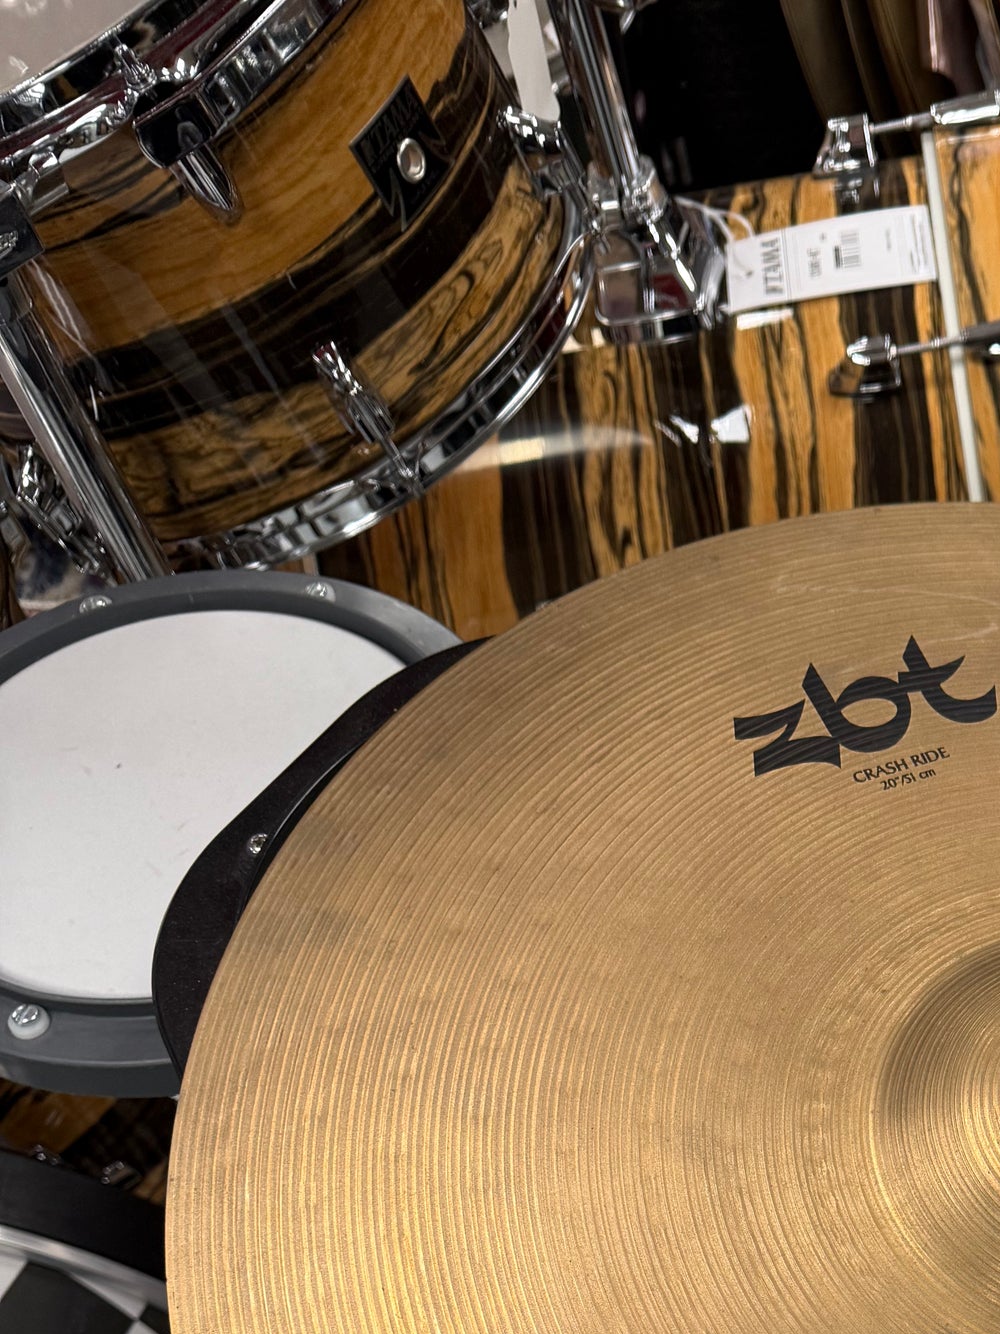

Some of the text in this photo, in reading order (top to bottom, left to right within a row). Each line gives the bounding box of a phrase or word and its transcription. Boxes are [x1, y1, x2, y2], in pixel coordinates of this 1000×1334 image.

[760, 237, 782, 284] TAMA
[733, 634, 998, 777] zbt
[852, 746, 950, 783] CRASH RIDE
[880, 768, 937, 791] 20"/51 cm
